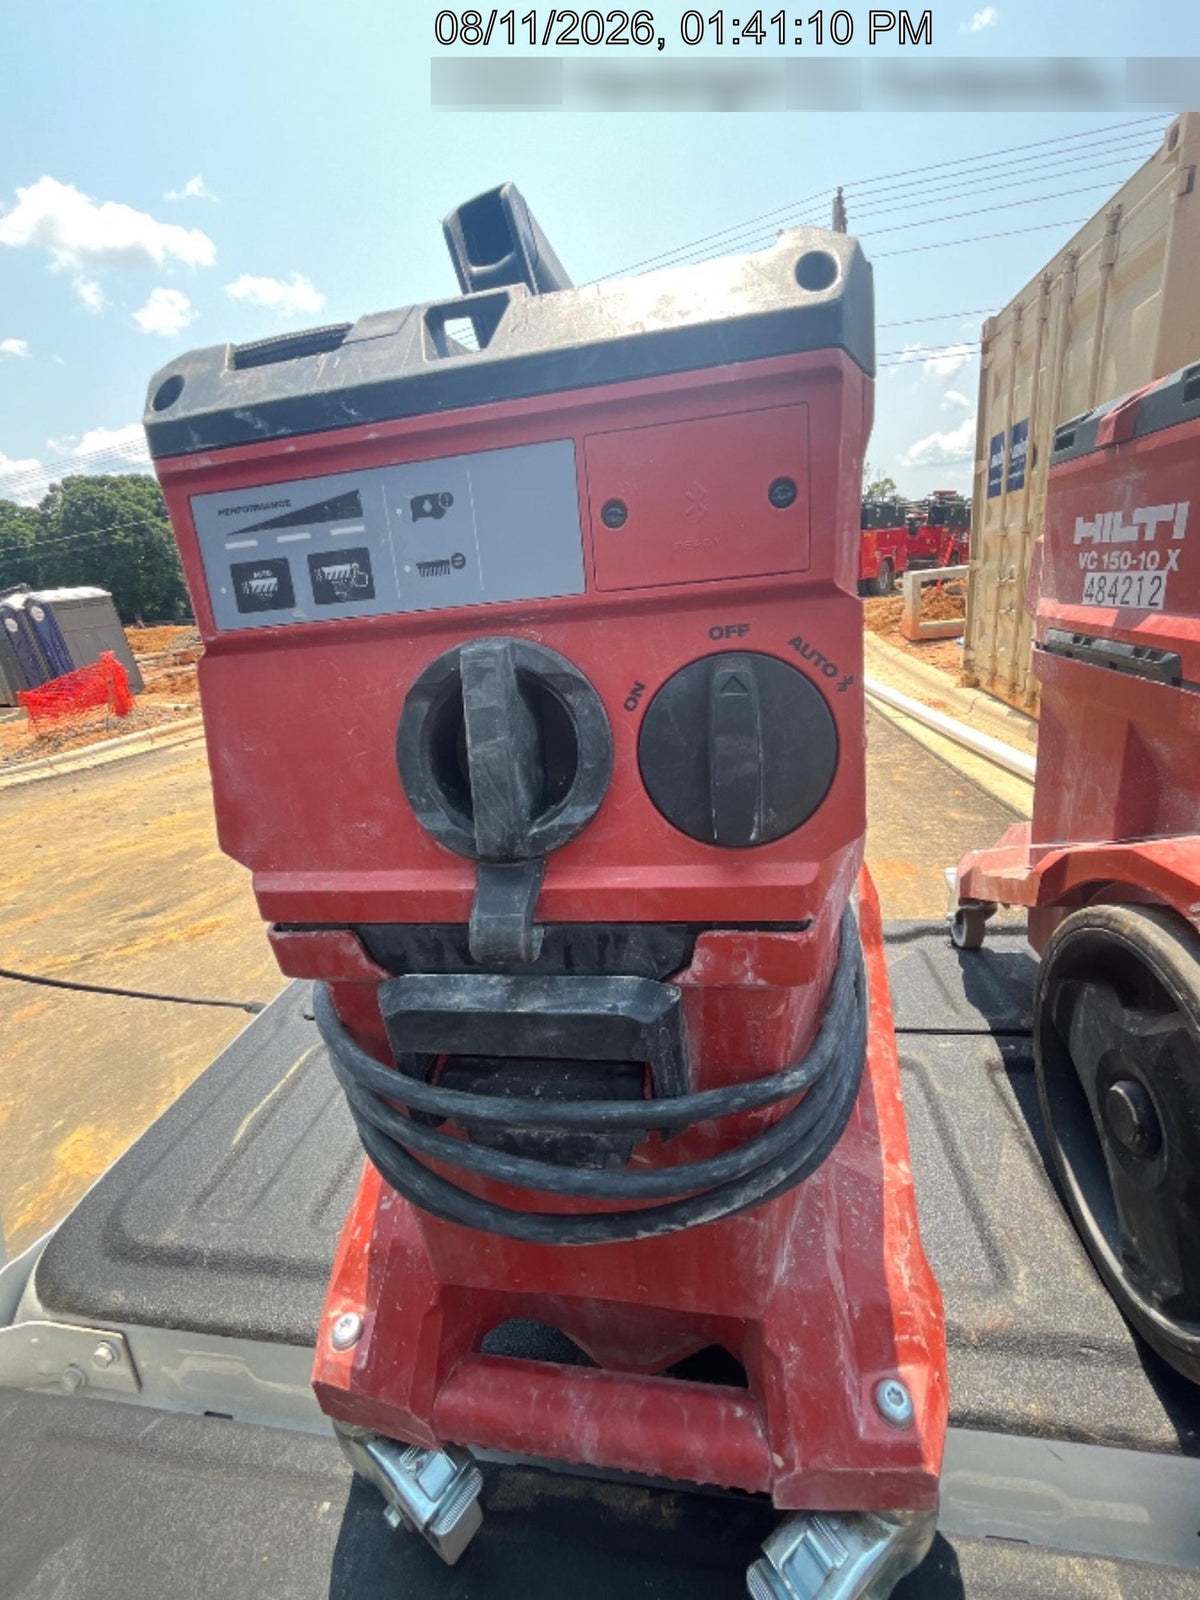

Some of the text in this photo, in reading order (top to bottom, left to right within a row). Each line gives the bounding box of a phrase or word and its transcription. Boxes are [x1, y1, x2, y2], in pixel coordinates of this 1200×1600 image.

[218, 499, 292, 516] PERFORMANCE
[1073, 501, 1190, 544] HILTI
[1079, 549, 1181, 571] VC 150-10 X
[1085, 575, 1162, 606] 484212
[708, 624, 750, 641] OFF
[788, 636, 838, 680] AUTO
[624, 681, 646, 712] ON
